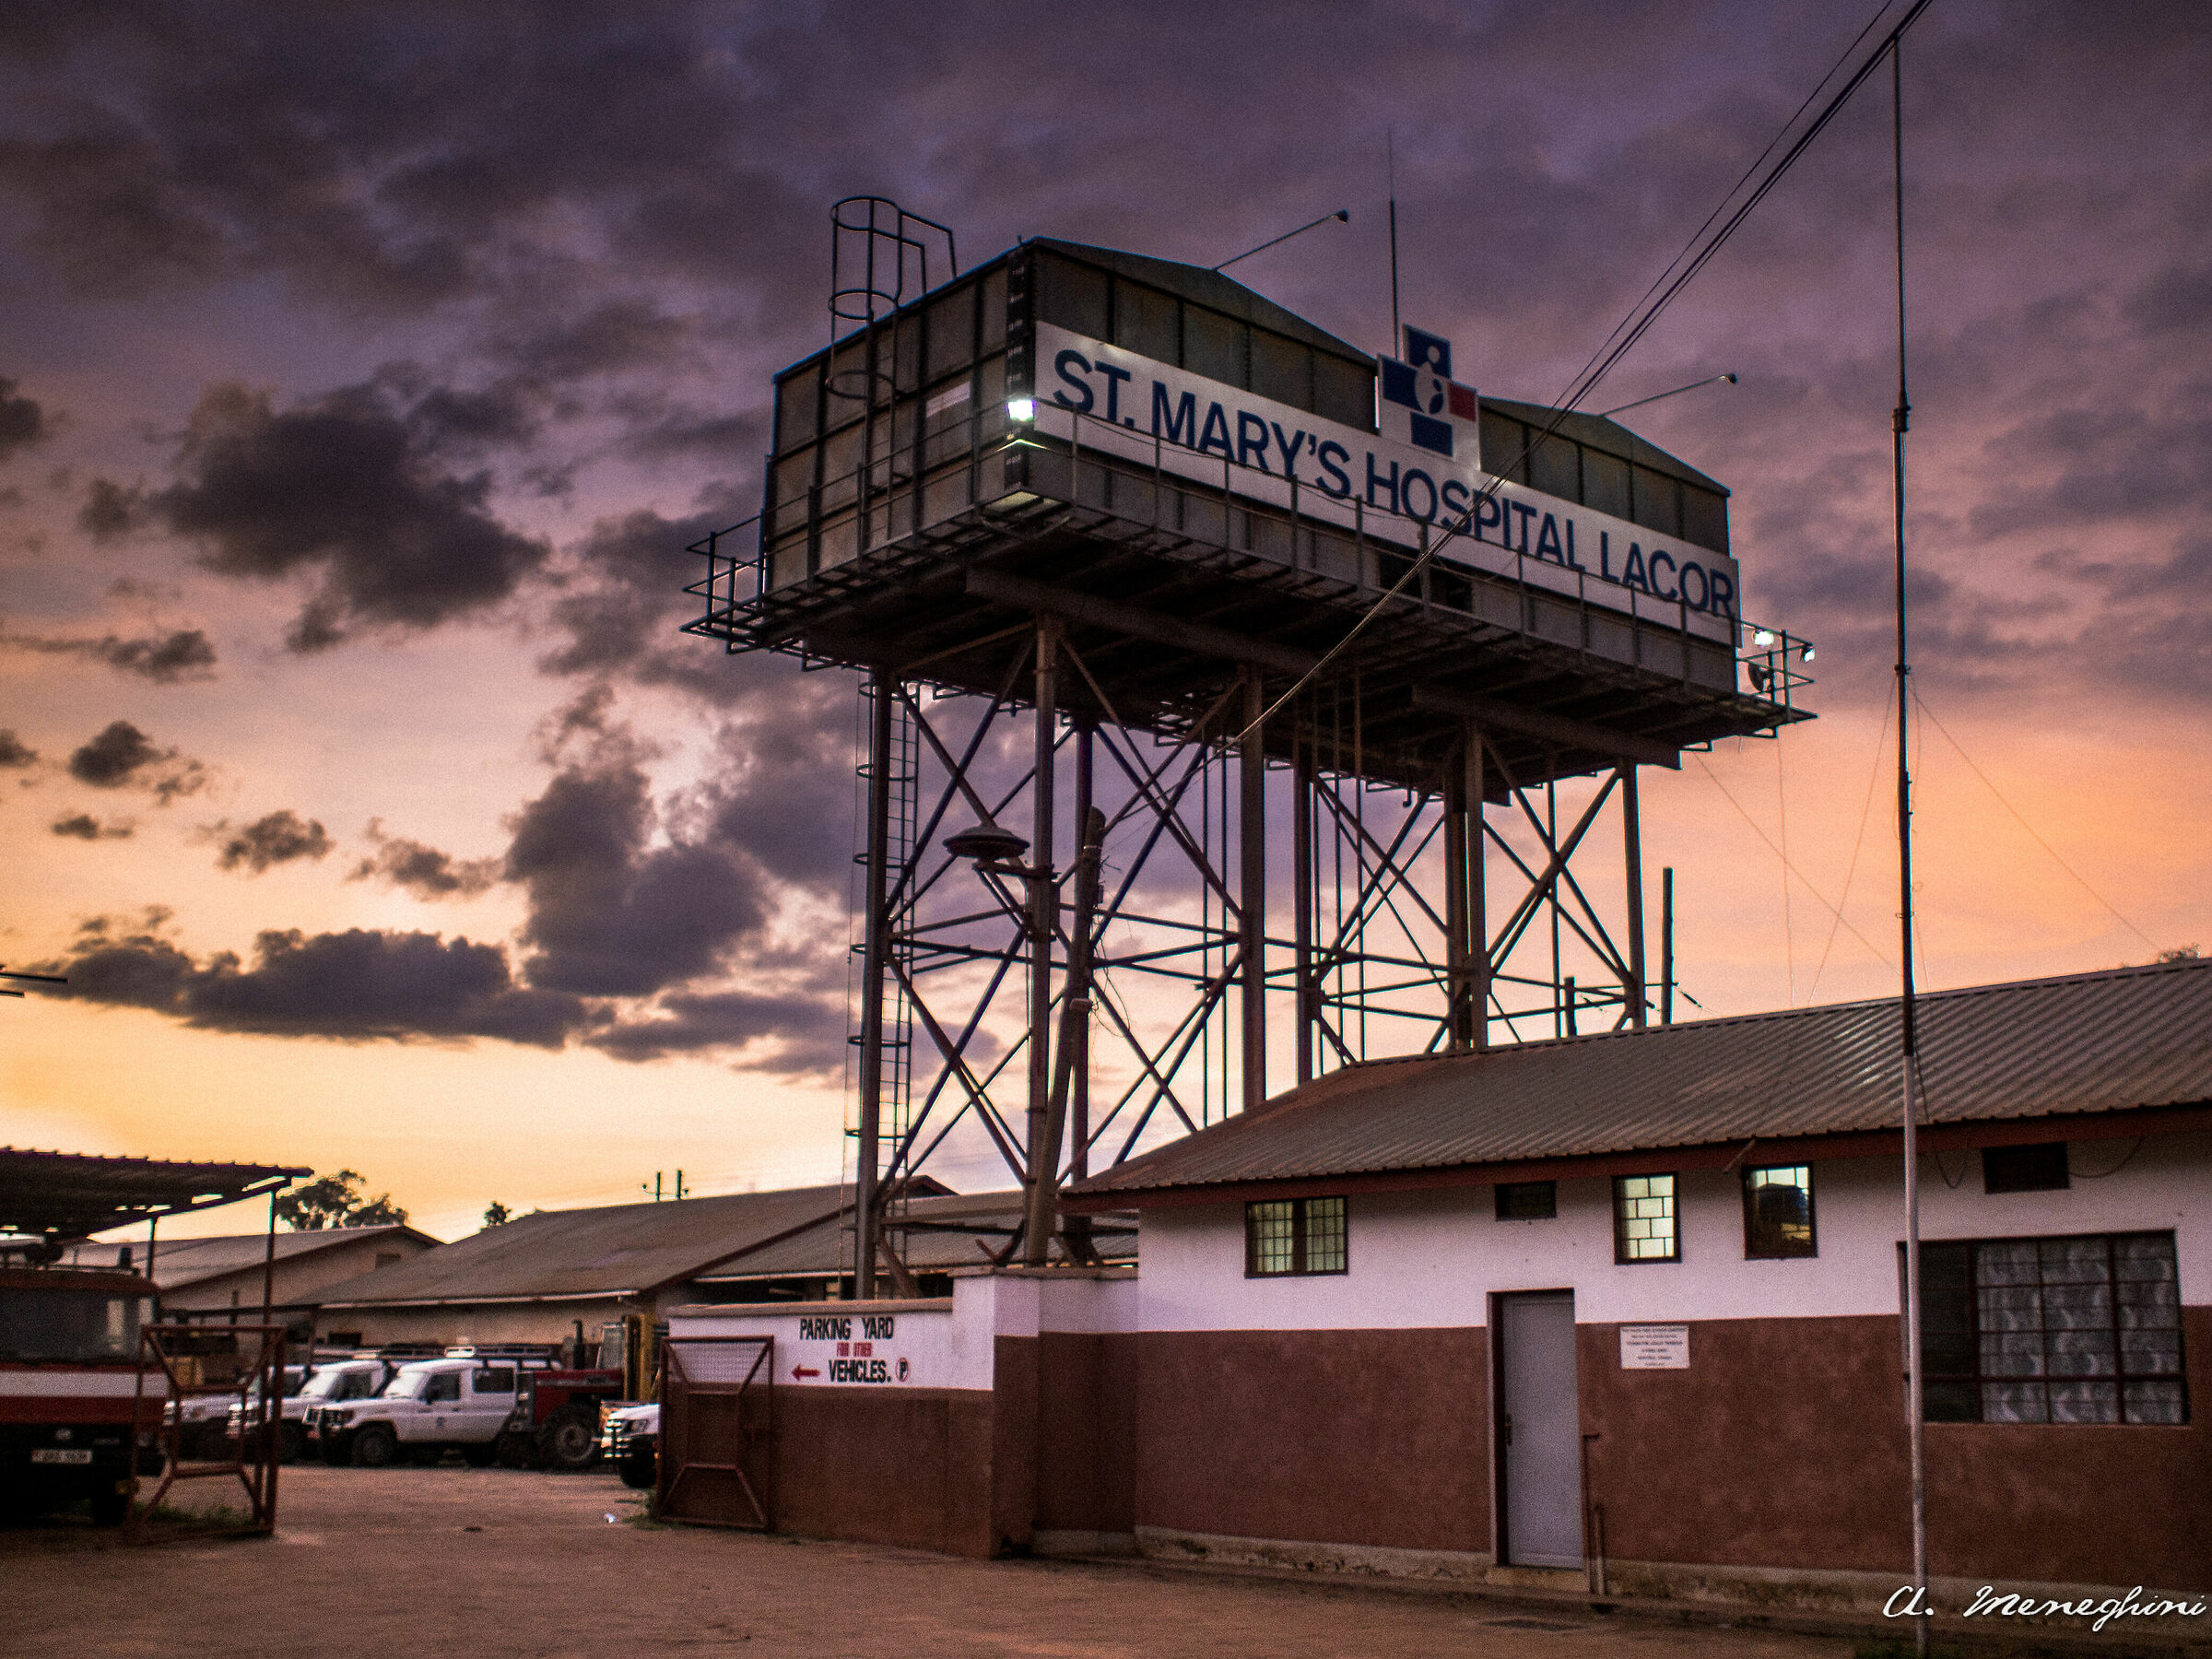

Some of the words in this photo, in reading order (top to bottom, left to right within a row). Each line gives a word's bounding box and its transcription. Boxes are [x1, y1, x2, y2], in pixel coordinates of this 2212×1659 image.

[1053, 349, 1135, 429] ST.
[1151, 380, 1351, 500] MARY'S
[1366, 451, 1586, 573] HOSPITAL
[1600, 531, 1735, 617] LACOR
[799, 1318, 852, 1340] PARKING
[862, 1316, 894, 1339] YARD
[829, 1359, 892, 1382] VEHICLES.
